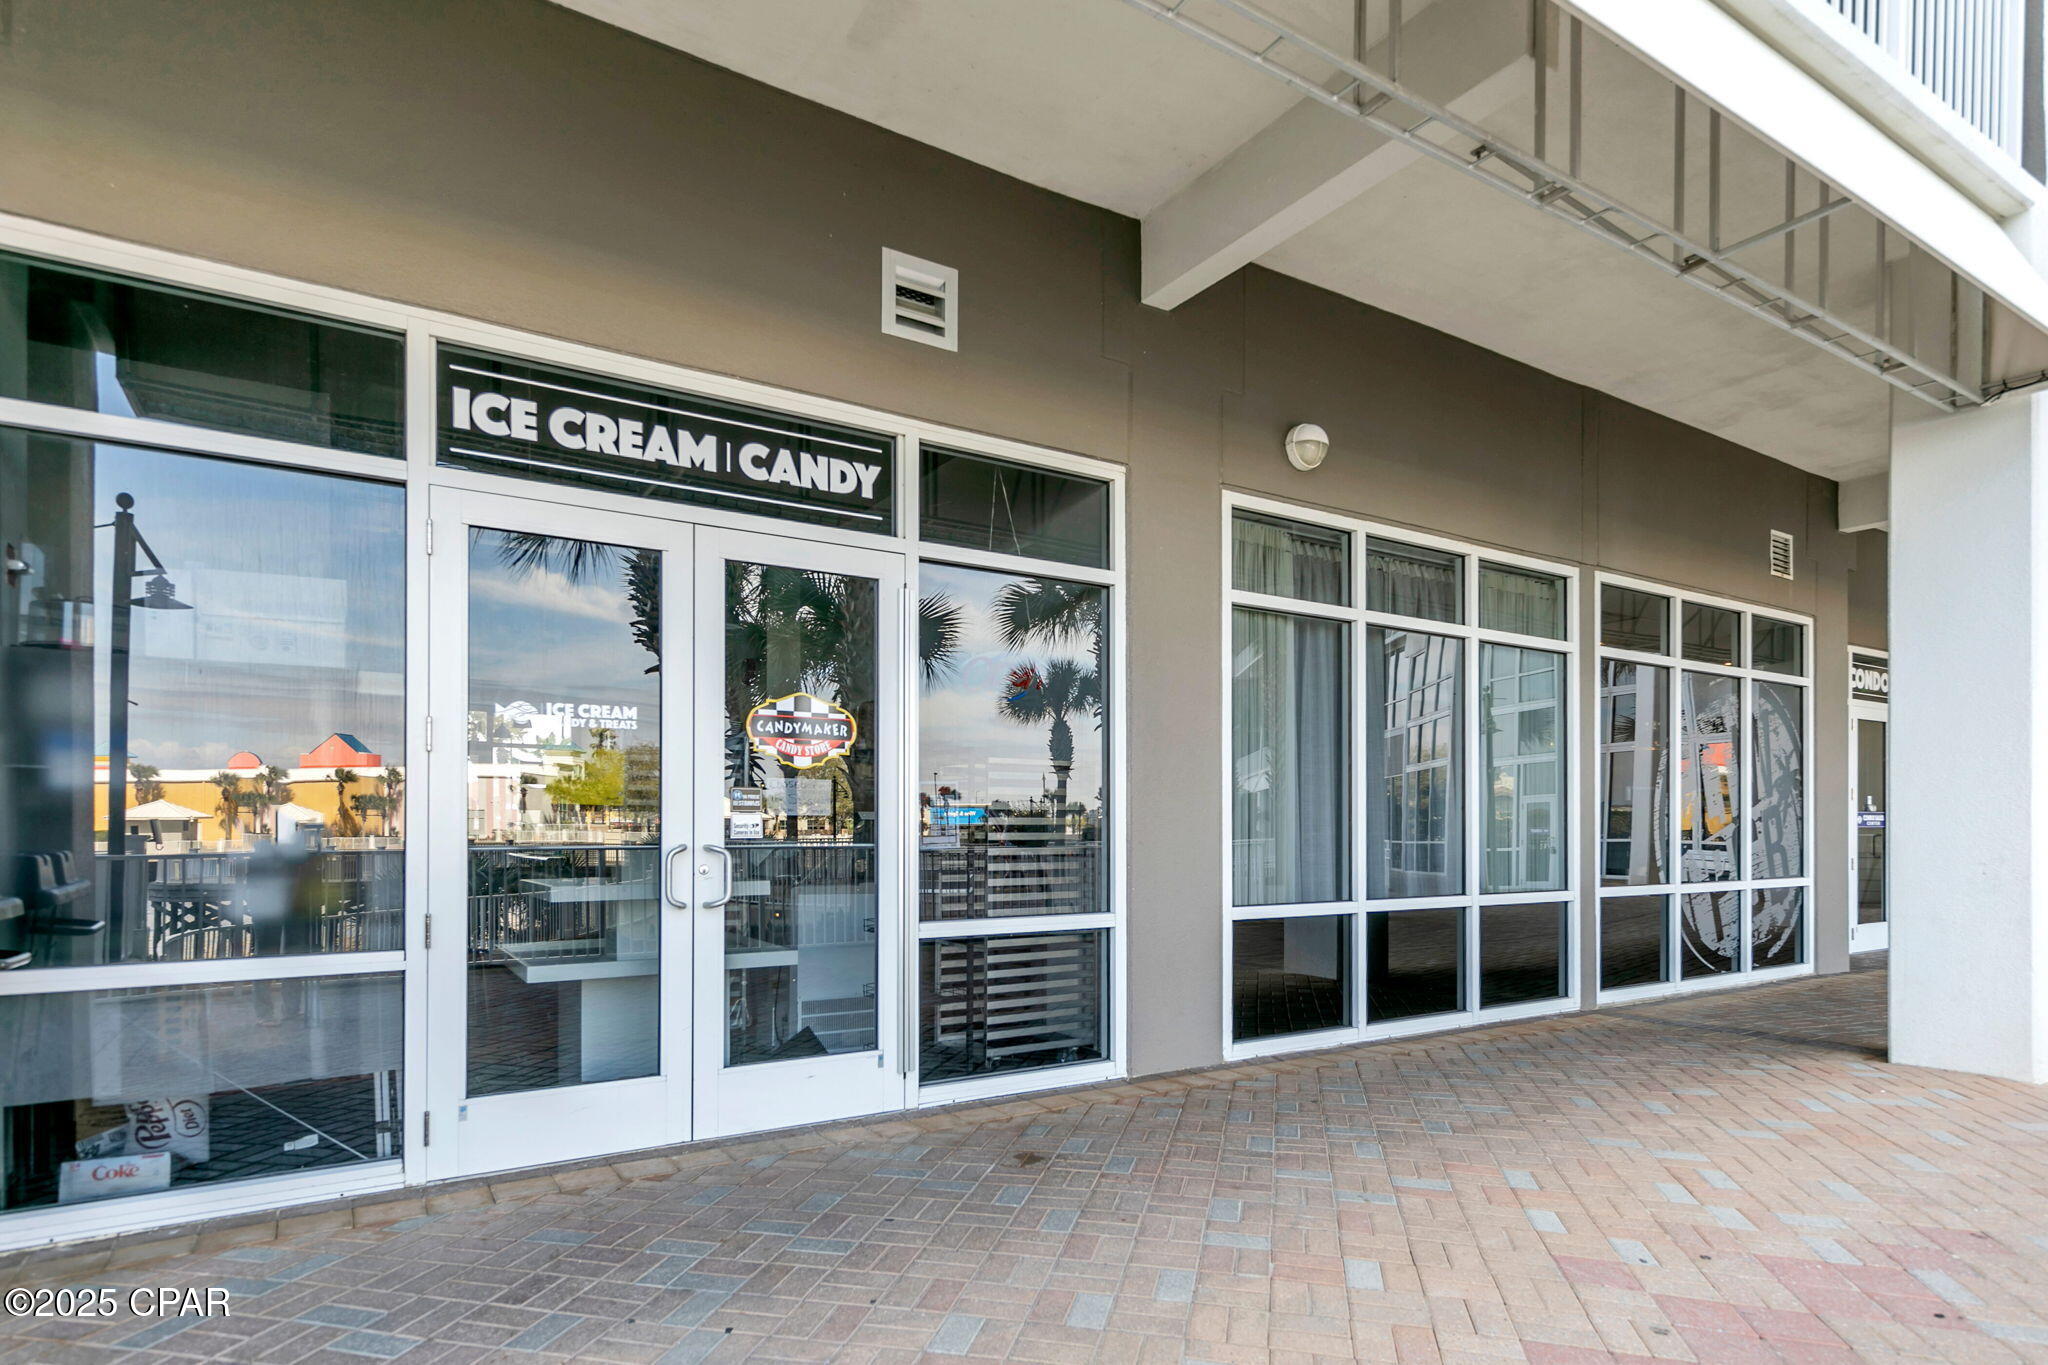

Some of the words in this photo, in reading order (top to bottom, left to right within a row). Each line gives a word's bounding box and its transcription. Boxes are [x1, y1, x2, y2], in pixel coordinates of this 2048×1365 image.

[450, 385, 539, 442] ICE
[547, 406, 718, 474] CREAM
[738, 441, 882, 500] CANDY
[546, 702, 574, 718] ICE
[578, 704, 638, 720] CREAM
[588, 719, 598, 729] &
[600, 720, 638, 730] TREATS
[756, 720, 848, 738] CANDYMAKER
[775, 739, 801, 756] CANDY
[804, 740, 832, 756] STORE
[92, 1164, 139, 1181] Coke
